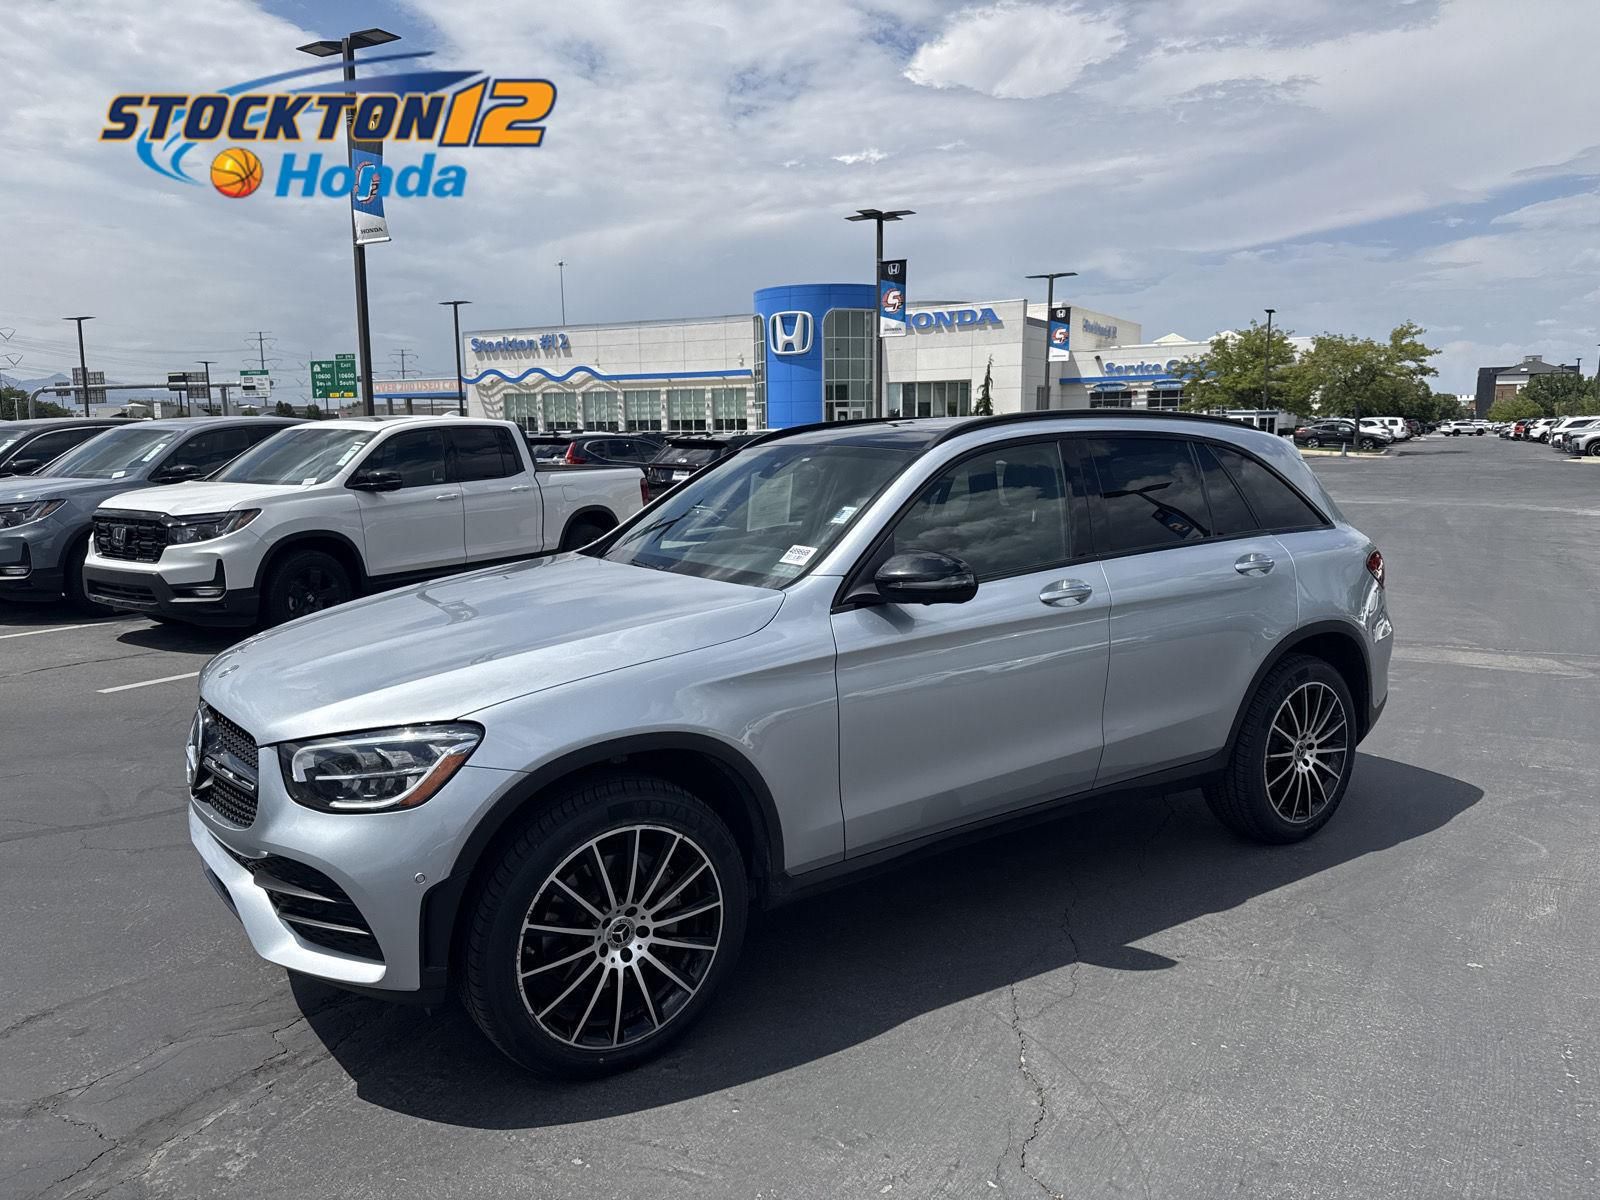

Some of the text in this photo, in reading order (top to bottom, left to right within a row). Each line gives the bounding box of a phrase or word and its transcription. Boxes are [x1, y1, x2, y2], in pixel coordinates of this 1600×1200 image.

[361, 227, 383, 235] HONDA
[471, 336, 537, 352] Stockton
[1105, 361, 1162, 375] Service
